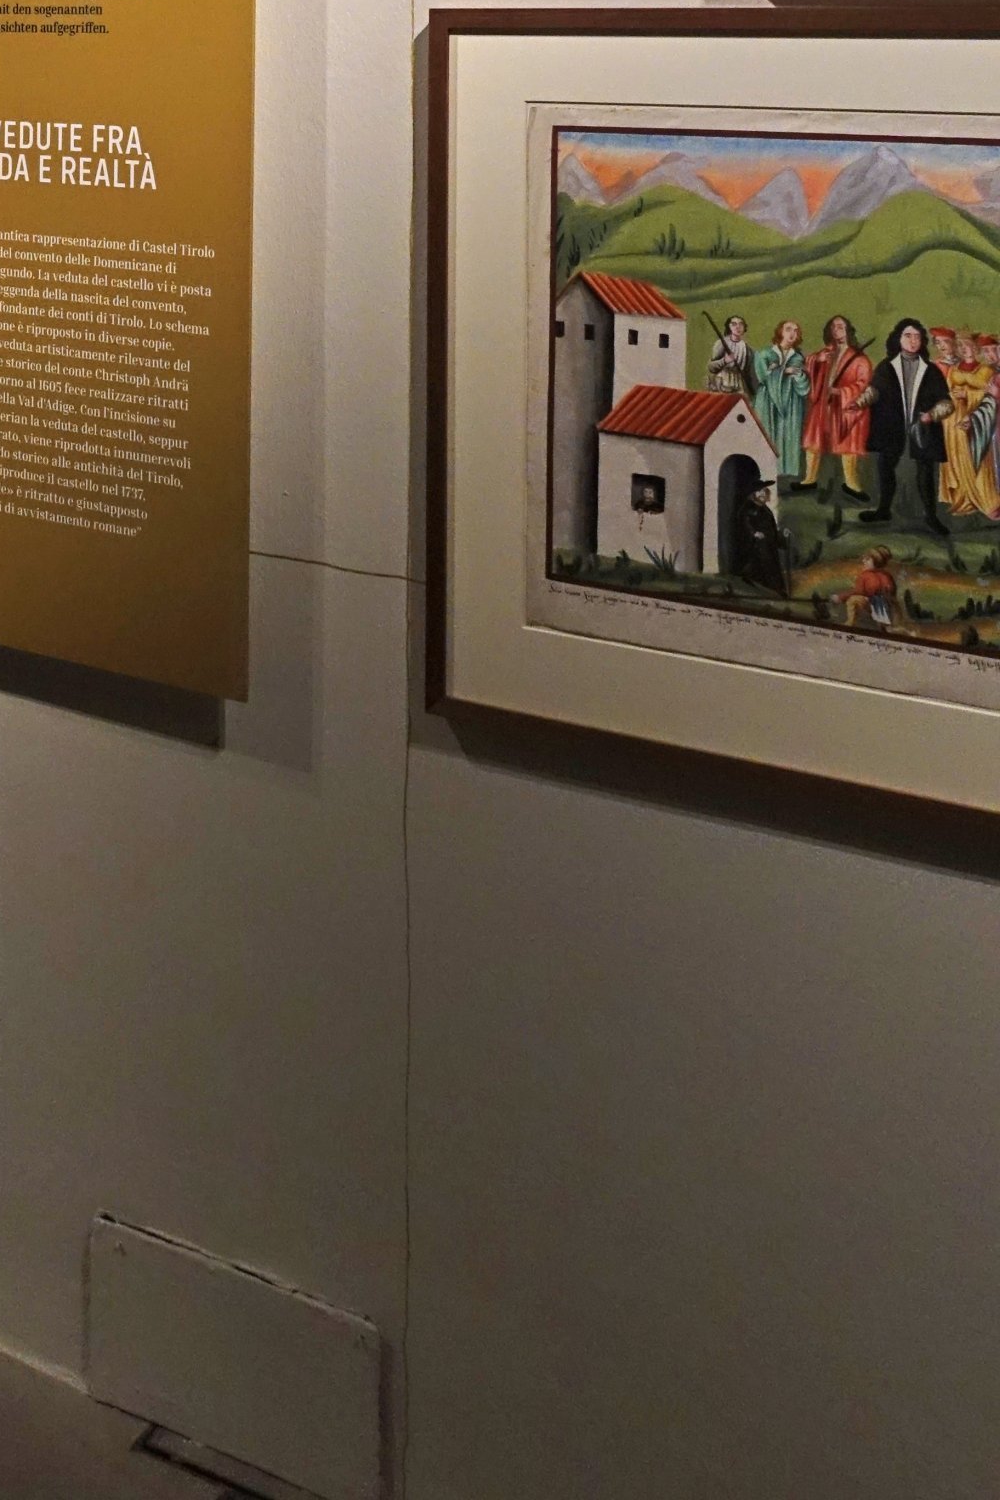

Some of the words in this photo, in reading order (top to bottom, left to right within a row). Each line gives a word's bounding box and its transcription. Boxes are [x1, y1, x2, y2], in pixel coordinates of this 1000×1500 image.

[39, 21, 110, 37] aufgegriffen.
[92, 124, 143, 155] FRA
[38, 154, 52, 184] E
[61, 153, 157, 190] REALTÀ
[14, 249, 63, 264] convento
[64, 252, 91, 267] delle
[93, 255, 163, 274] Domenicane
[164, 261, 177, 275] di
[31, 233, 127, 251] rappresentazione
[128, 238, 141, 253] di
[142, 240, 178, 256] Castel
[179, 243, 216, 260] Tirolo
[41, 286, 69, 302] della
[70, 292, 111, 307] nascita
[111, 294, 130, 308] del
[131, 299, 187, 316] convento,
[17, 320, 25, 334] è
[25, 322, 83, 341] riproposto
[84, 328, 96, 342] in
[97, 330, 140, 348] diverse
[141, 337, 176, 353] copie.
[34, 343, 117, 364] artisticamente
[118, 352, 171, 371] rilevante
[172, 358, 191, 373] del
[5, 357, 43, 372] storico
[44, 360, 61, 375] del
[62, 366, 93, 379] conte
[94, 367, 151, 388] Christoph
[152, 375, 189, 393] Andrä
[30, 413, 40, 428] la
[41, 417, 79, 434] veduta
[80, 421, 98, 436] del
[99, 427, 147, 445] castello,
[148, 435, 190, 451] seppur
[23, 432, 53, 448] viene
[54, 437, 112, 458] riprodotta
[113, 445, 192, 471] innumerevoli
